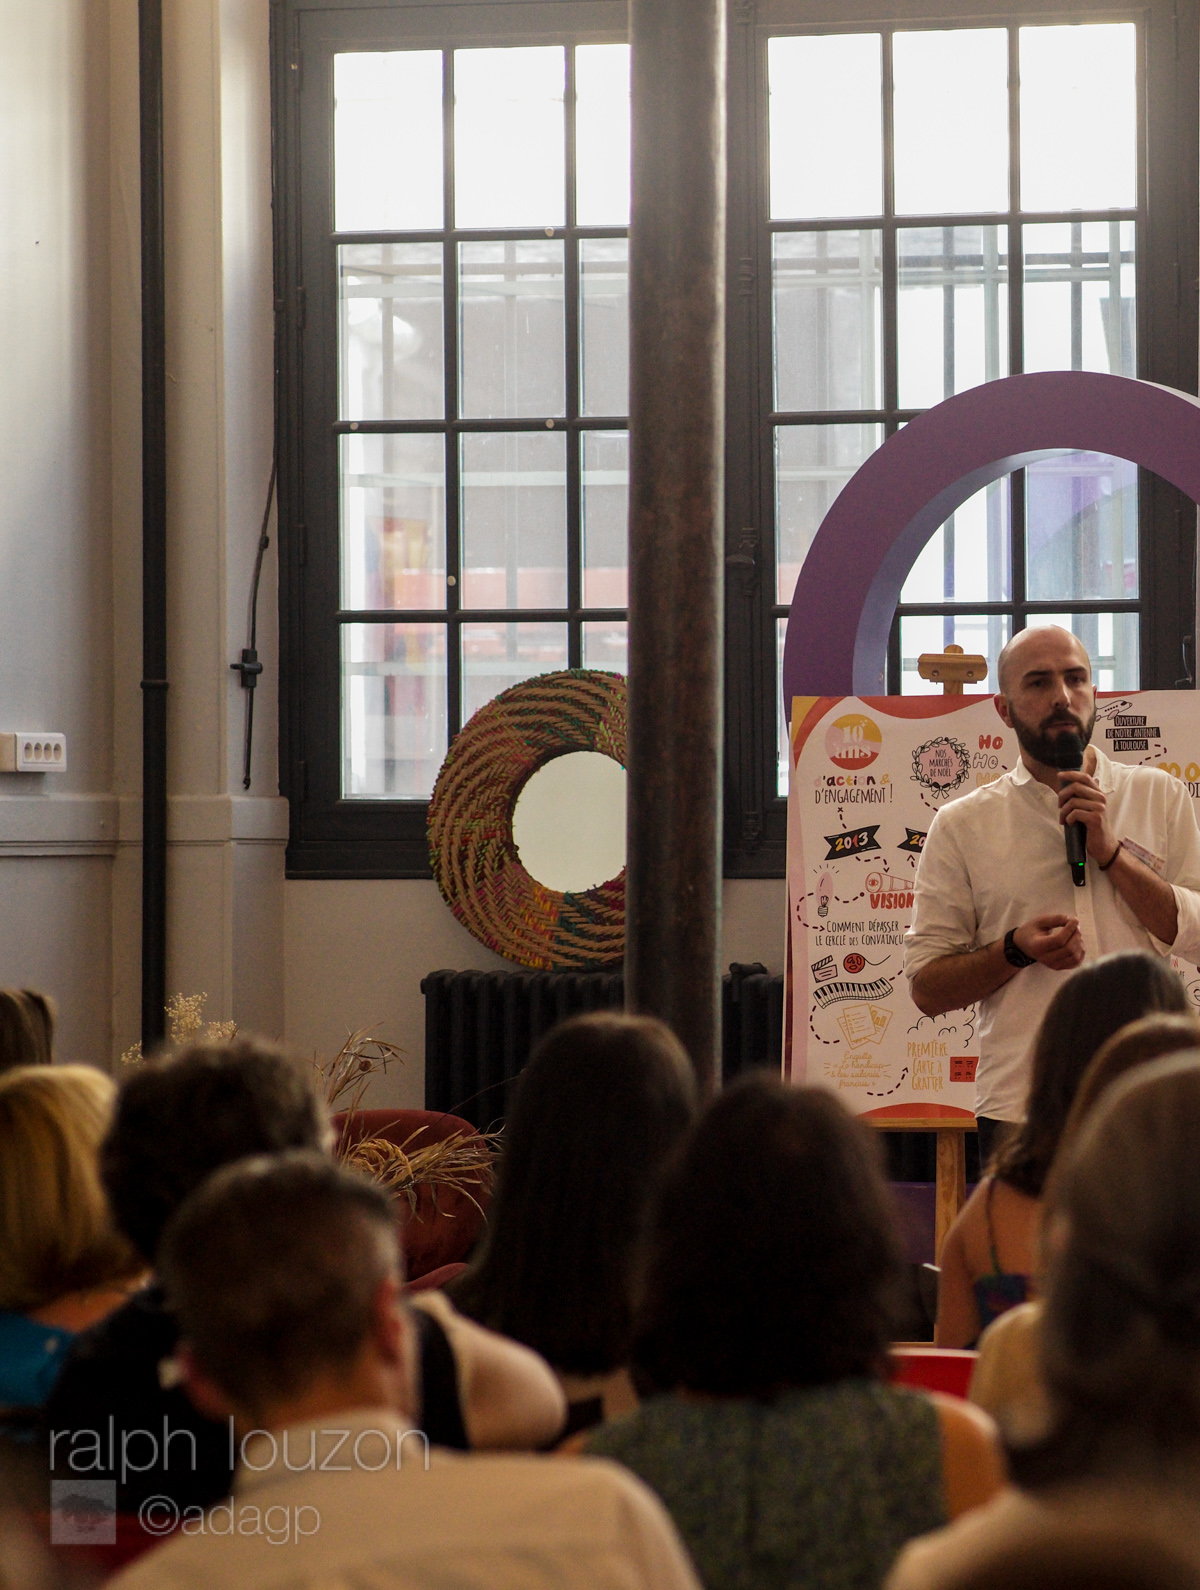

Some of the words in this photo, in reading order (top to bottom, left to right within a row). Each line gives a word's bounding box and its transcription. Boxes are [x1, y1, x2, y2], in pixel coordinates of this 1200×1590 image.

[843, 725, 863, 743] 10
[880, 774, 890, 785] &
[815, 788, 886, 804] D'ENGAGEMENT
[835, 832, 869, 851] 2013
[870, 892, 914, 909] VISION
[862, 934, 904, 946] CONVAINCU
